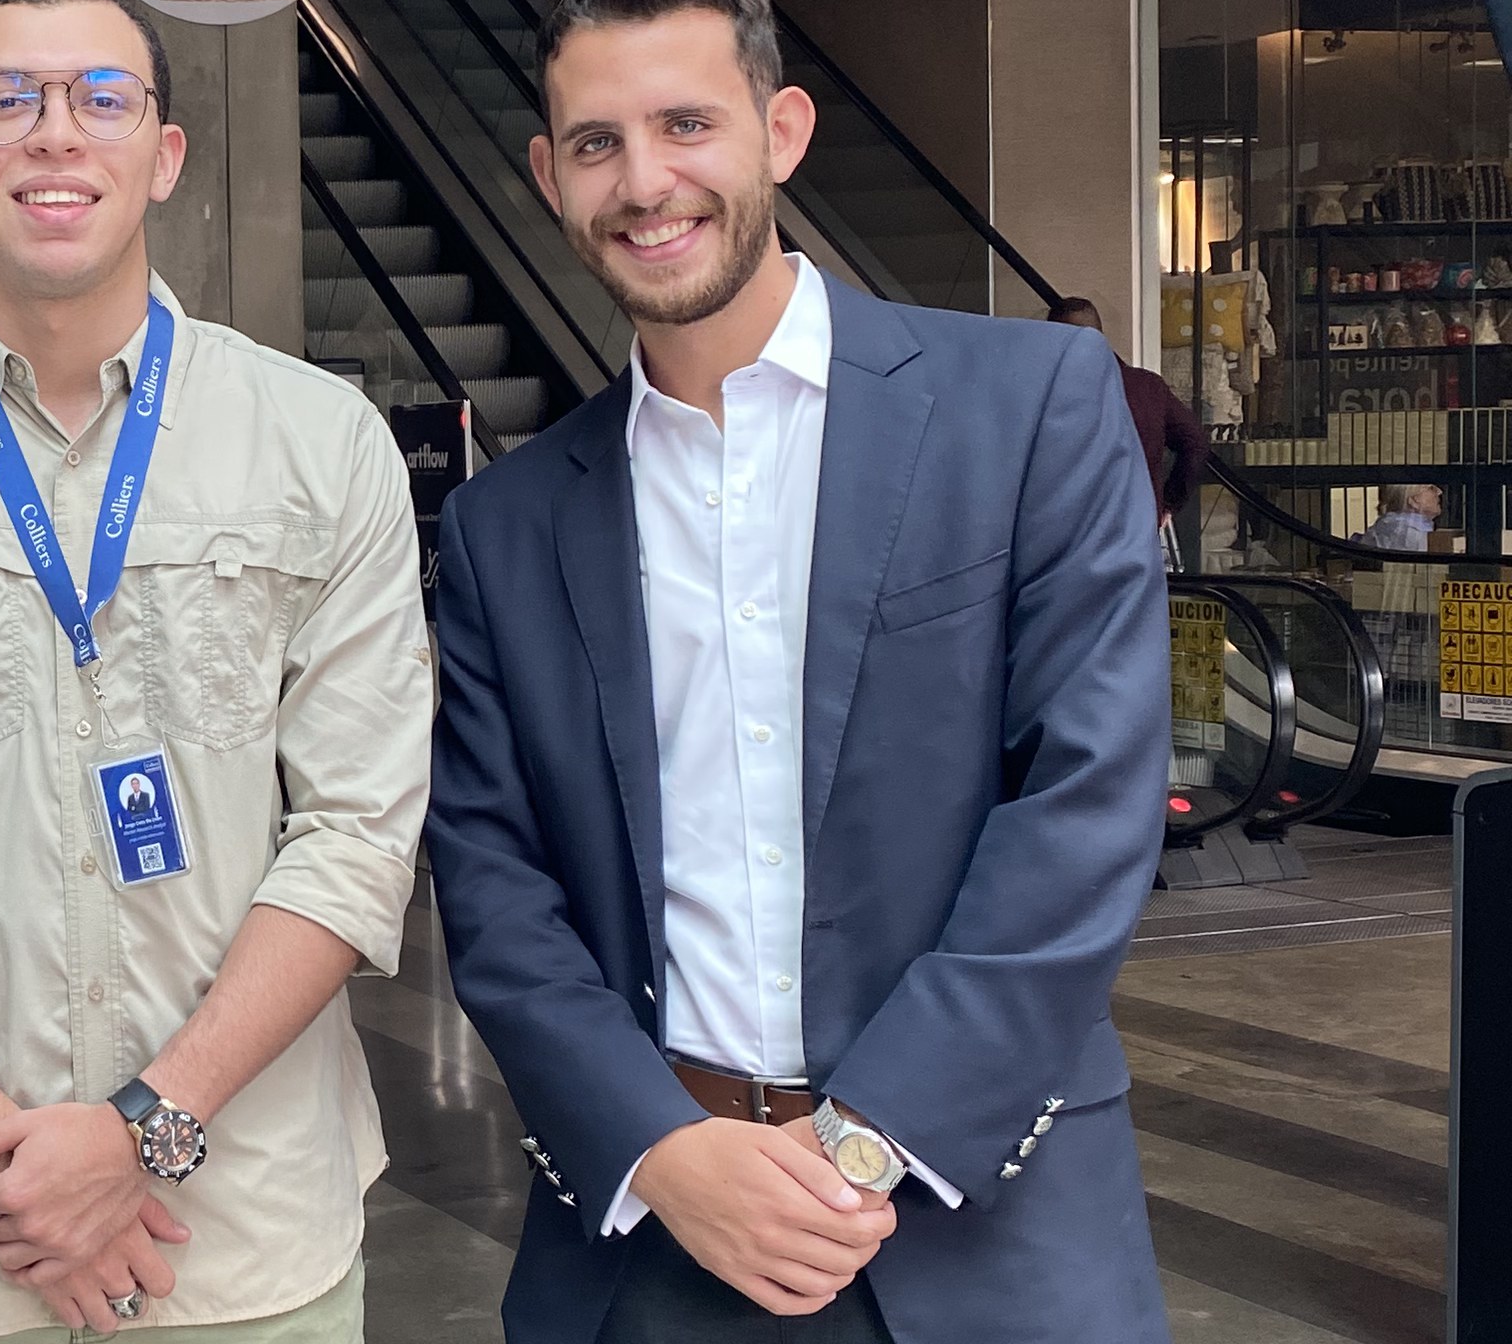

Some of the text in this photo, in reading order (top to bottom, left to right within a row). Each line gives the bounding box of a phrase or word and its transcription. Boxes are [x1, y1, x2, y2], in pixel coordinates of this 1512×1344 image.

[136, 355, 162, 417] Colliers
[407, 443, 449, 470] artflow
[20, 503, 52, 569] Colliers
[105, 474, 136, 539] Colliers
